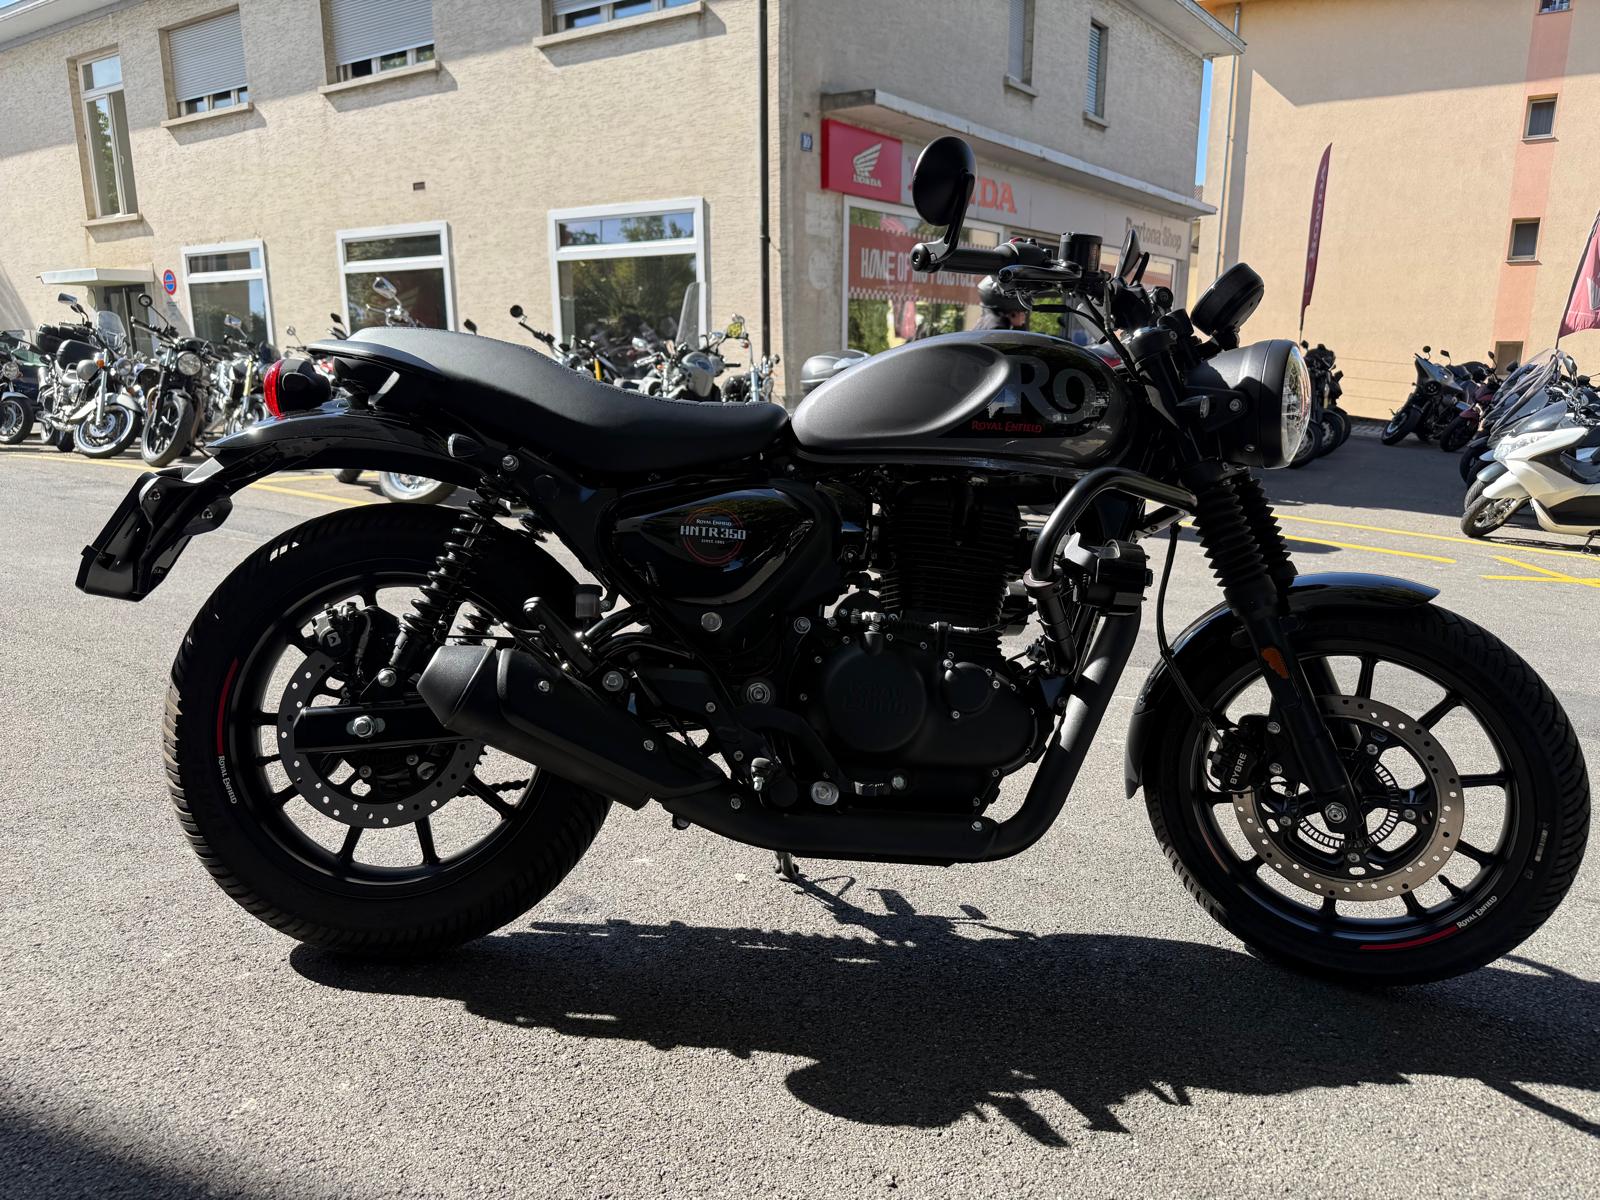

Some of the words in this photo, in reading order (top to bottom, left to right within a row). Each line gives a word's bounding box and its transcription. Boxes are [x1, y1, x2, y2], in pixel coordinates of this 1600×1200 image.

[971, 420, 1003, 431] ROYAL
[1004, 421, 1042, 433] ENFIELD
[218, 755, 228, 778] ROYAL
[1229, 752, 1247, 785] BYBRE
[1456, 913, 1478, 929] ROYAL
[1474, 895, 1498, 917] ENFIELD
